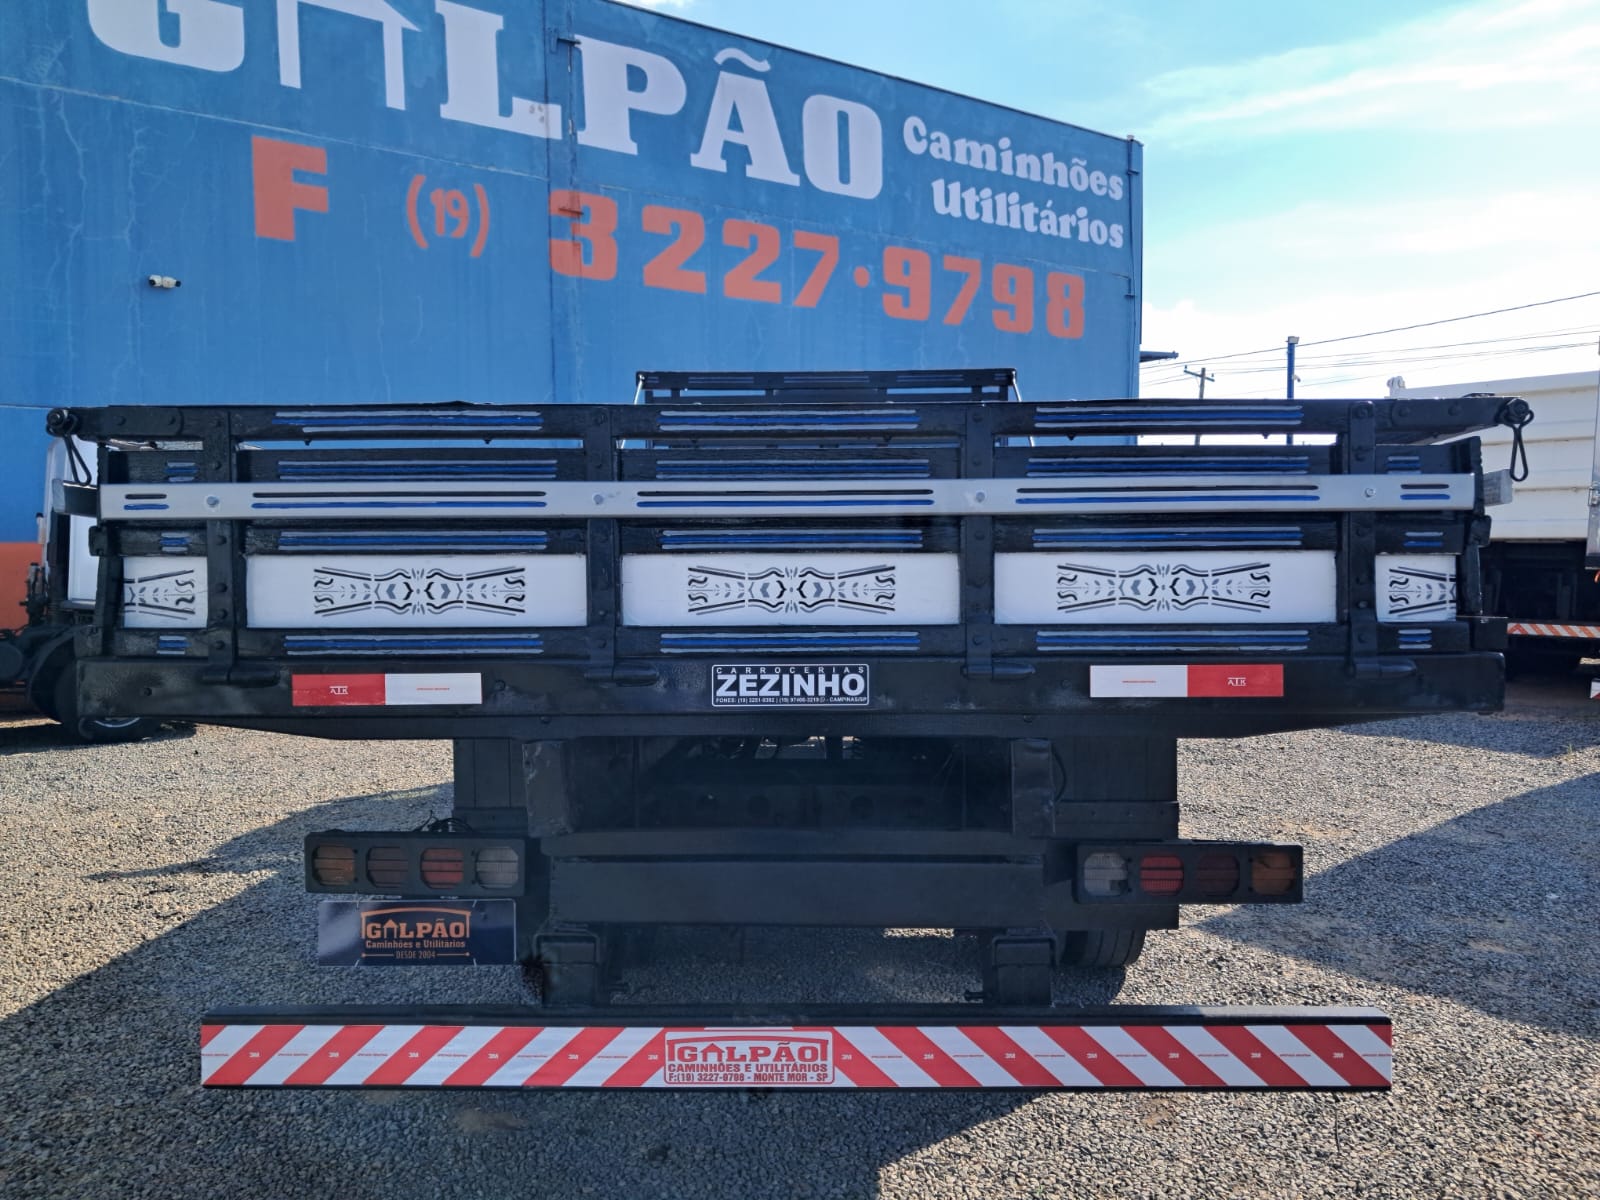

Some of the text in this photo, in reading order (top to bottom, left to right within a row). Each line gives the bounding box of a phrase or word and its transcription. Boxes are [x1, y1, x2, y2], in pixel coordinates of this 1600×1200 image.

[903, 116, 1123, 200] Caminhões
[252, 136, 328, 241] F
[407, 175, 490, 258] (19)
[931, 178, 1123, 248] Utilitários
[716, 666, 864, 674] CARROCERIAS
[716, 673, 865, 697] ZEZINHO
[396, 950, 436, 960] DESDE 2004
[668, 1061, 828, 1073] CAMINHÕES E UTILITÁRIOS
[753, 1072, 785, 1082] MONTE
[787, 1072, 808, 1082] MOR
[816, 1072, 828, 1082] SP
